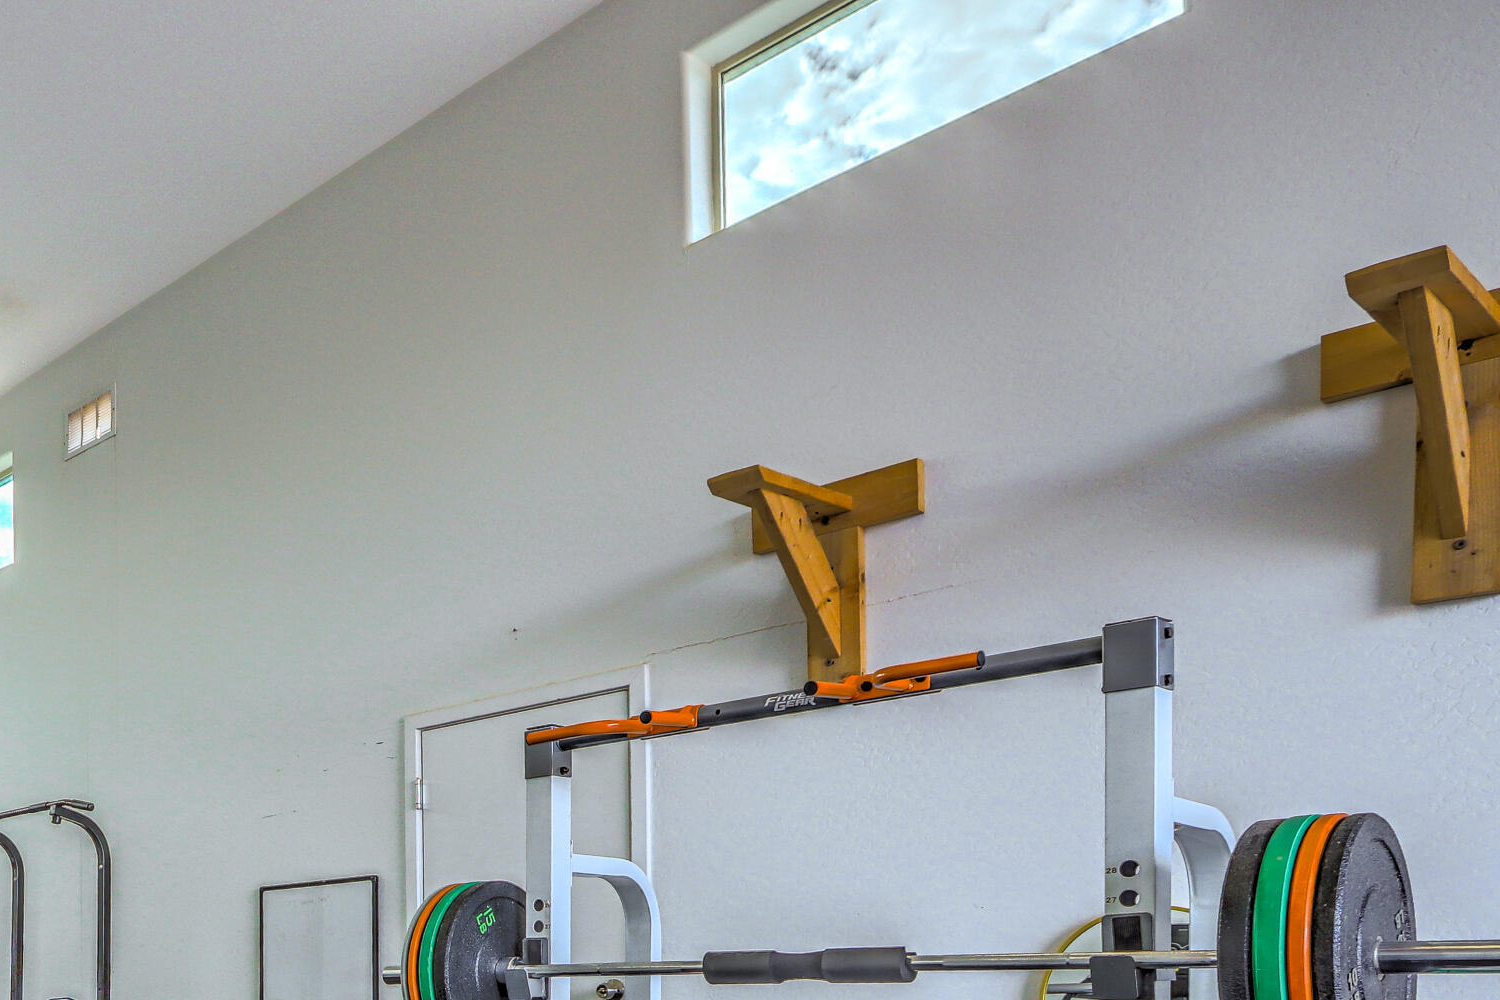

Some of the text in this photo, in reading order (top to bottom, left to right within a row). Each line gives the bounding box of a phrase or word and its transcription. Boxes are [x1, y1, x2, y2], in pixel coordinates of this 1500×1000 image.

[764, 692, 806, 707] FITNE
[774, 695, 816, 712] GEAR
[1106, 896, 1116, 904] 27
[476, 913, 488, 934] LB
[483, 907, 496, 926] 15
